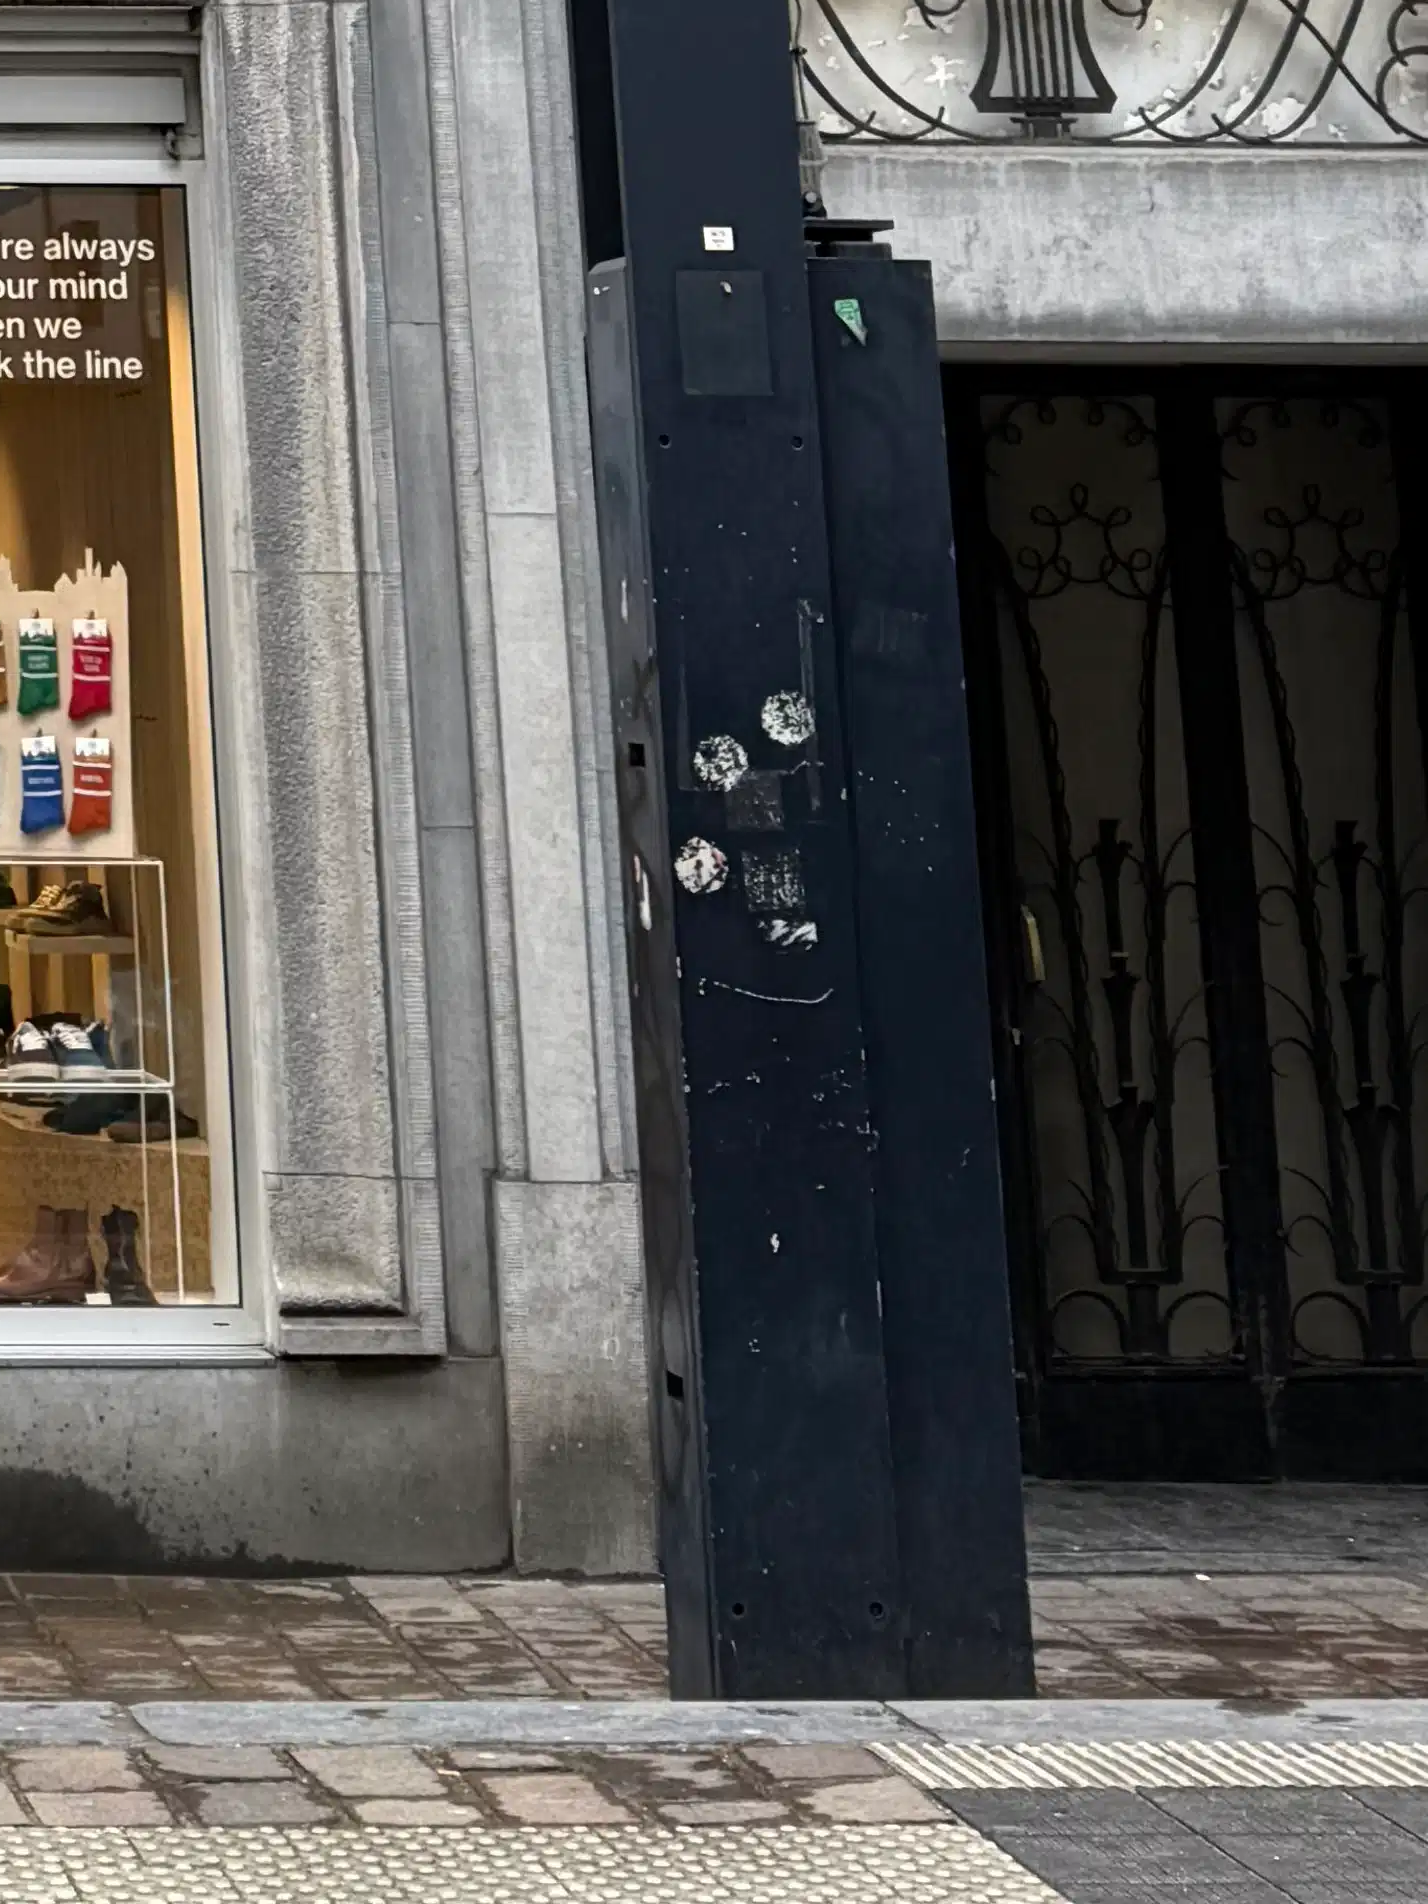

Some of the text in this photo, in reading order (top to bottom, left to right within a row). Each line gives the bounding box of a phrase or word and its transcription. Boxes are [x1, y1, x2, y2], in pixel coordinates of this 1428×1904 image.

[43, 231, 156, 267] always
[48, 270, 129, 300] mind
[33, 316, 83, 340] we
[22, 348, 77, 380] the
[84, 348, 144, 380] line
